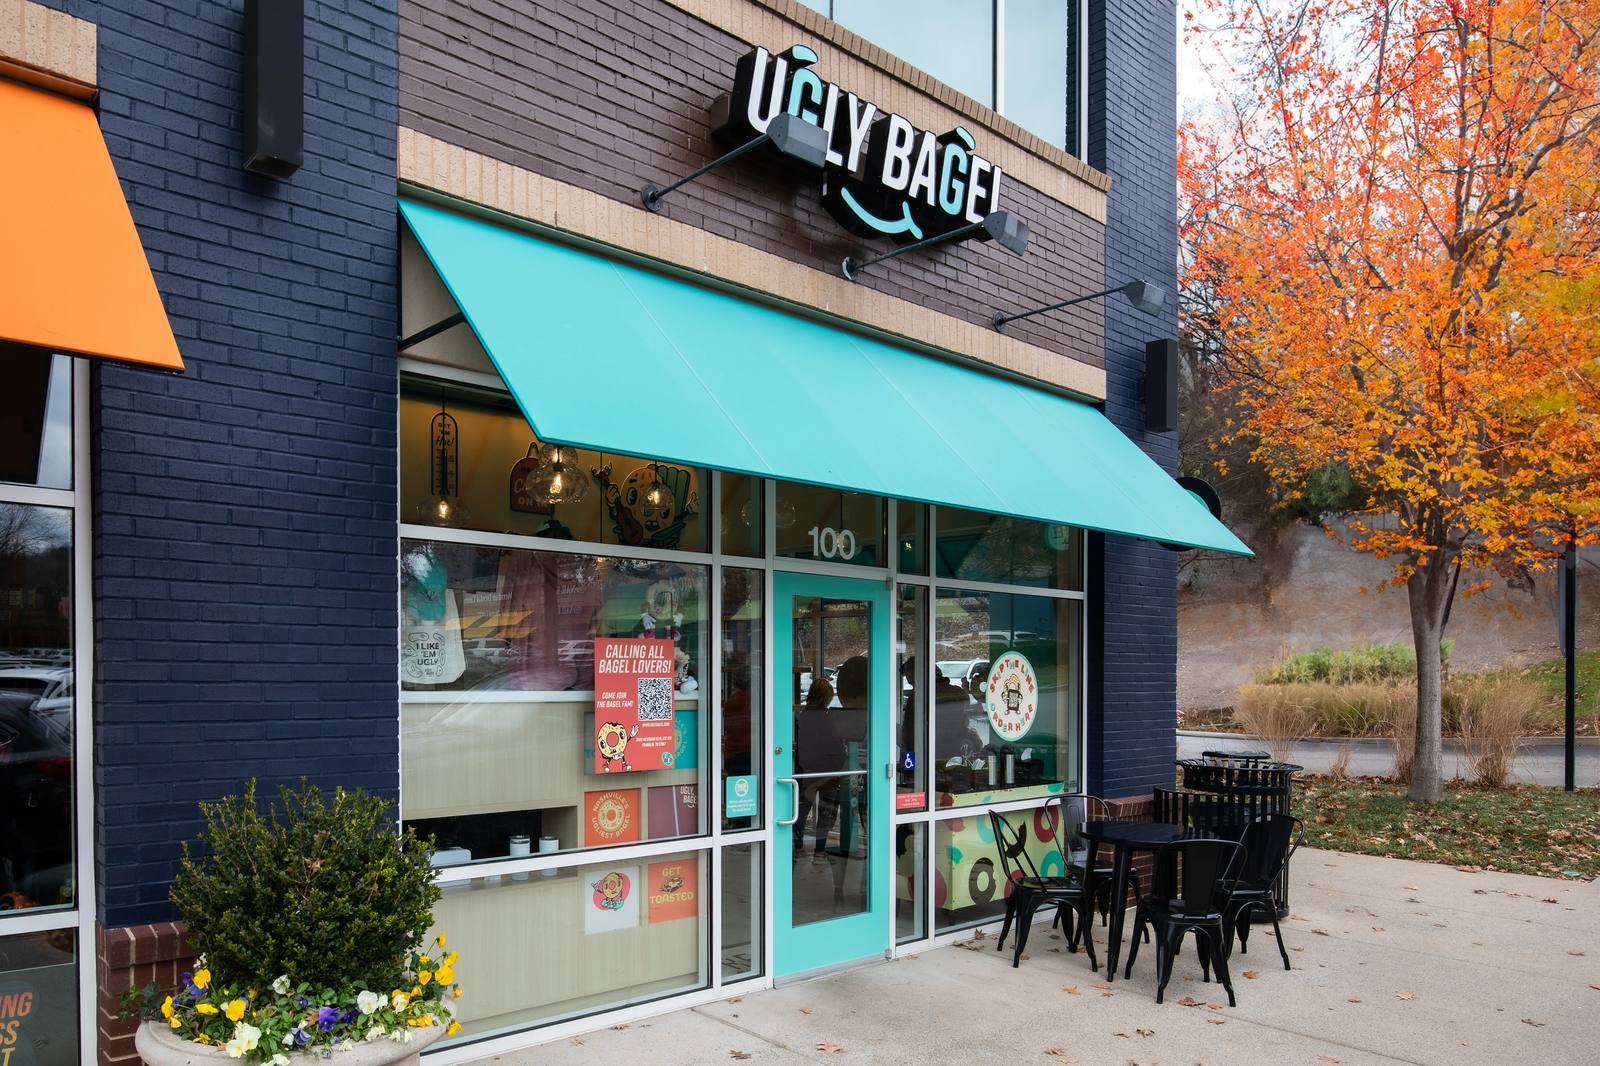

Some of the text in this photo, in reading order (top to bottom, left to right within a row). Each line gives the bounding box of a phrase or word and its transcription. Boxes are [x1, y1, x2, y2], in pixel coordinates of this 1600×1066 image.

[746, 45, 877, 173] UGLY
[808, 526, 856, 560] 100
[421, 642, 440, 650] LIKE
[605, 644, 665, 659] CALLING ALL
[421, 650, 437, 658] 'EM
[417, 658, 439, 666] UGLY
[599, 659, 672, 674] BAGEL LOVERS!
[990, 659, 1035, 693] SKIP THE LINE
[616, 691, 627, 699] JOIN
[606, 700, 622, 708] BAGEL
[990, 703, 1033, 732] ORDER HERE
[592, 813, 631, 838] UGLIEST BAGEL
[661, 866, 682, 877] GET
[649, 890, 694, 904] TOASTED
[0, 992, 33, 1018] NG
